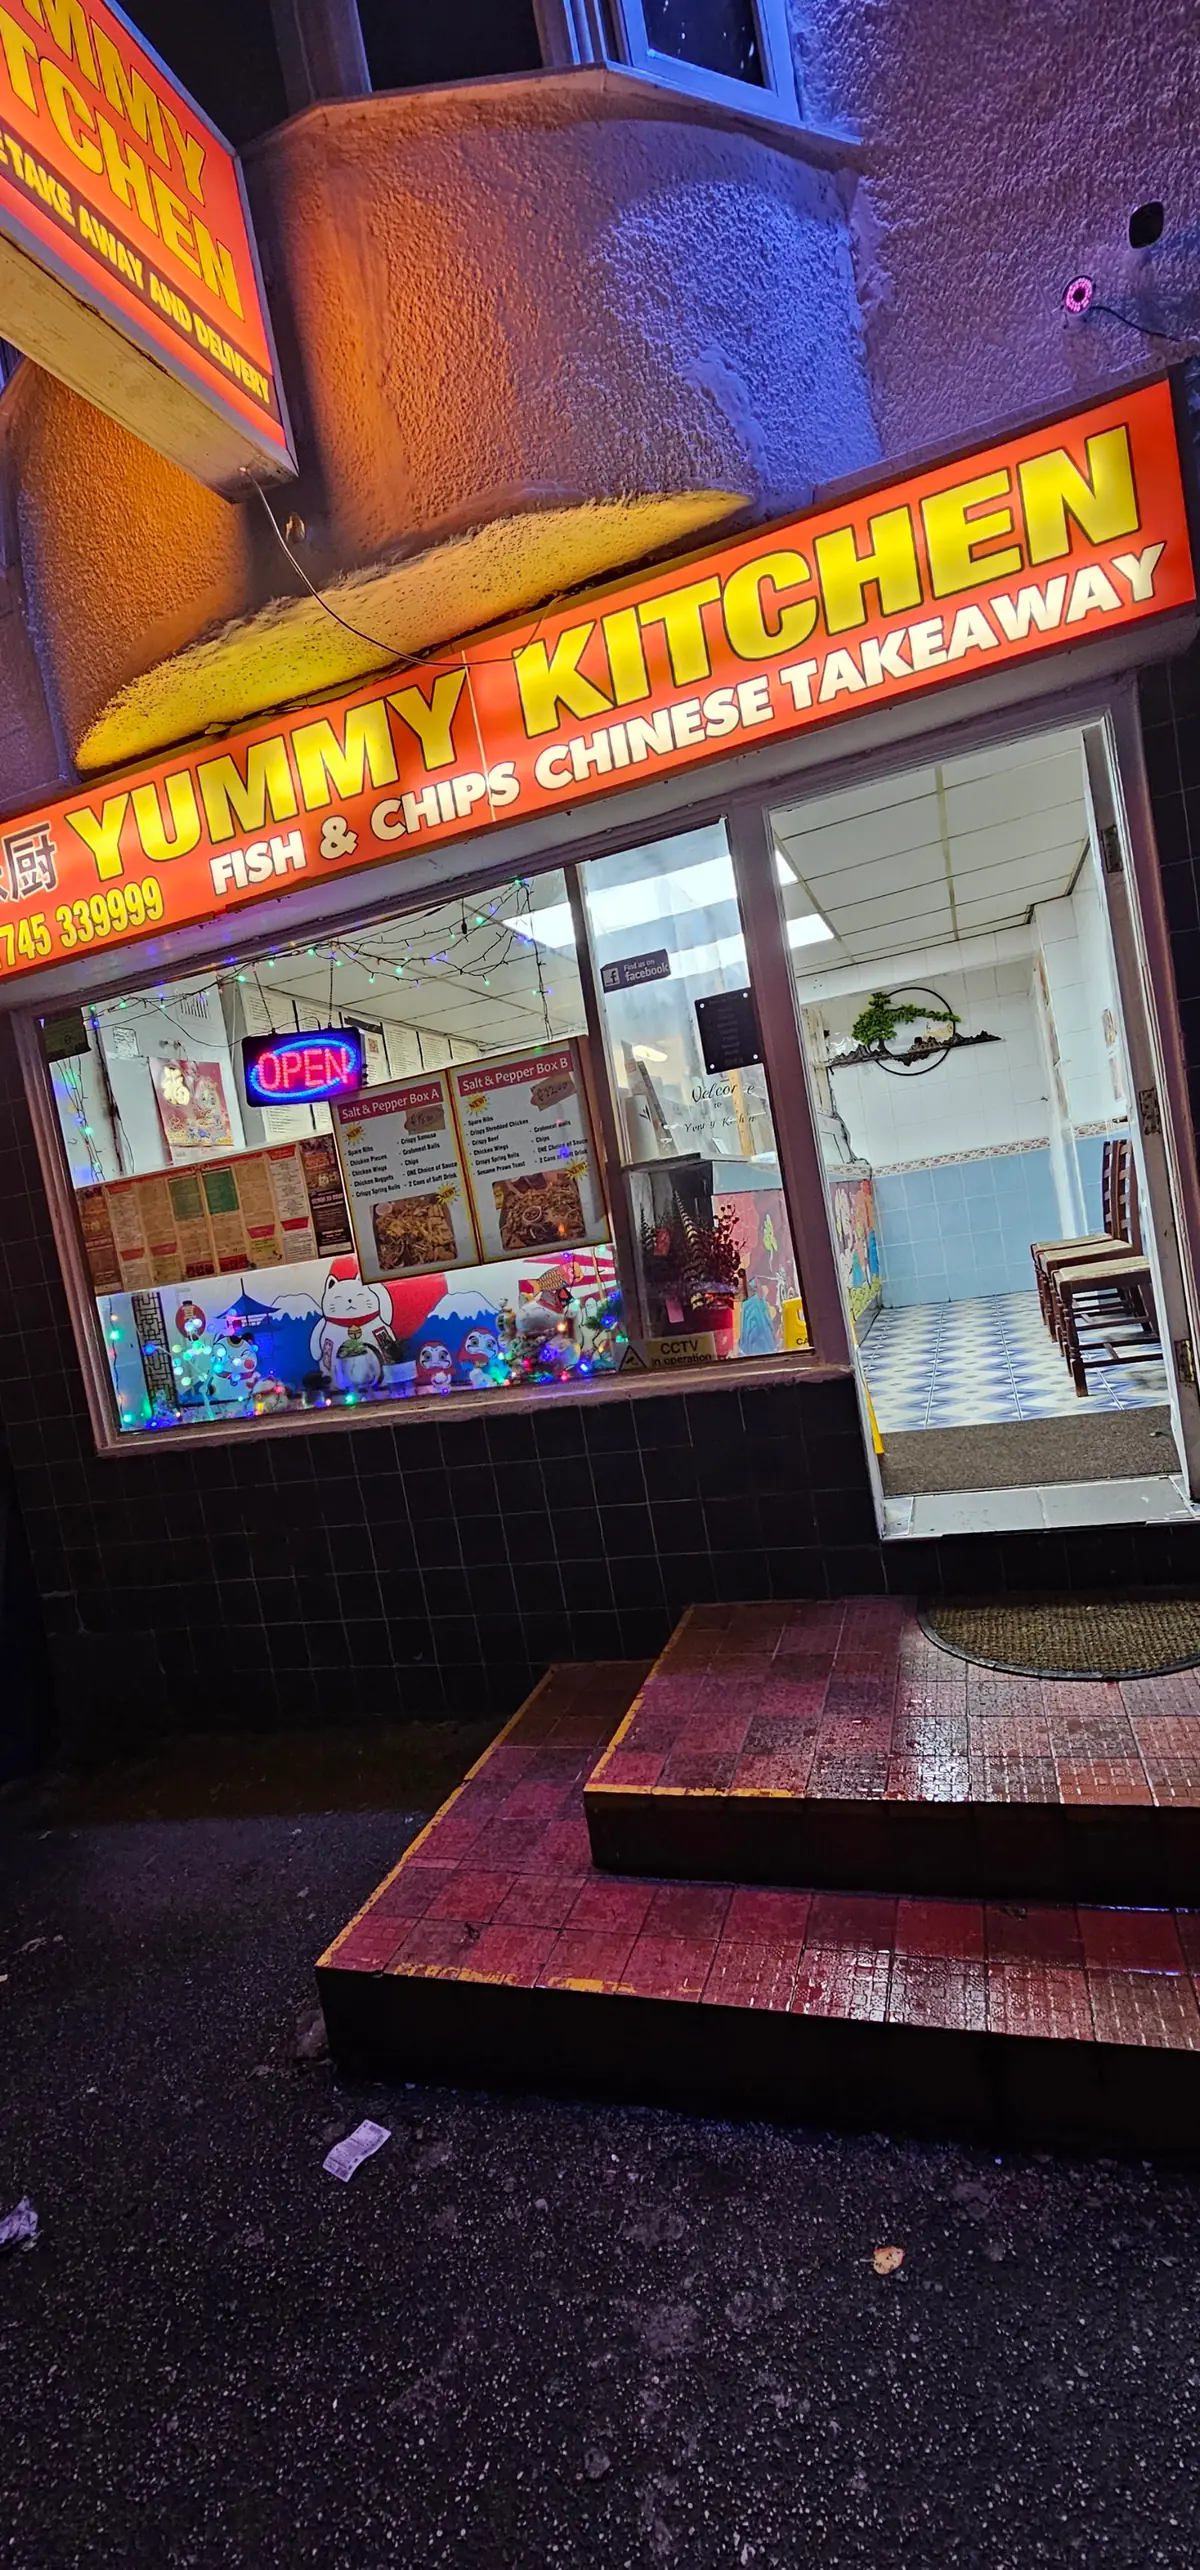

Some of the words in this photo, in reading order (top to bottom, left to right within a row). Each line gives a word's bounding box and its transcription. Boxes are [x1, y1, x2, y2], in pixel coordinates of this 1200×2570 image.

[4, 133, 76, 228] TAKE
[78, 205, 145, 290] AWAY
[150, 272, 193, 332] AND
[193, 312, 270, 404] DELIVERY
[65, 666, 467, 881] YUMMY
[512, 423, 1141, 738] KITCHEN
[209, 829, 307, 897] FISH
[319, 815, 359, 861] &
[370, 760, 521, 842] CHIPS
[534, 674, 775, 790] CHINESE
[780, 541, 1167, 711] TAKEAWAY
[0, 820, 57, 902] 厨
[0, 912, 52, 968] 745
[55, 876, 164, 948] 339999
[624, 962, 637, 971] Find
[625, 962, 668, 981] facebook
[258, 1048, 348, 1091] OPEN
[463, 1081, 482, 1091] Salt
[485, 1076, 494, 1085] &
[495, 1067, 534, 1082] Pepper
[536, 1062, 558, 1073] Box
[560, 1058, 568, 1068] B
[342, 1107, 360, 1119] Salt
[362, 1105, 371, 1114] &
[372, 1097, 408, 1112] Pepper
[410, 1092, 429, 1104] Box
[431, 1089, 440, 1099] A
[486, 1123, 508, 1132] Shredded
[534, 1123, 556, 1132] Crabmeat
[401, 1138, 416, 1146] Crispy
[472, 1138, 486, 1146] Crispy
[403, 1147, 426, 1155] Crabmeat
[474, 1147, 493, 1155] Chicken
[494, 1144, 508, 1152] Wings
[350, 1158, 370, 1166] Chicken
[405, 1158, 419, 1166] Chips
[476, 1158, 490, 1166] Crispy
[352, 1169, 372, 1177] Chicken
[373, 1165, 387, 1173] Wings
[418, 1165, 435, 1174] Choice
[477, 1167, 496, 1175] Sesame
[354, 1179, 374, 1187] Chicken
[375, 1175, 394, 1184] Nuggets
[413, 1178, 426, 1186] Cans
[432, 1174, 442, 1182] Soft
[356, 1189, 371, 1198] Crispy
[372, 1186, 387, 1194] Spring
[661, 1340, 698, 1354] CCTV
[664, 1353, 712, 1365] operation
